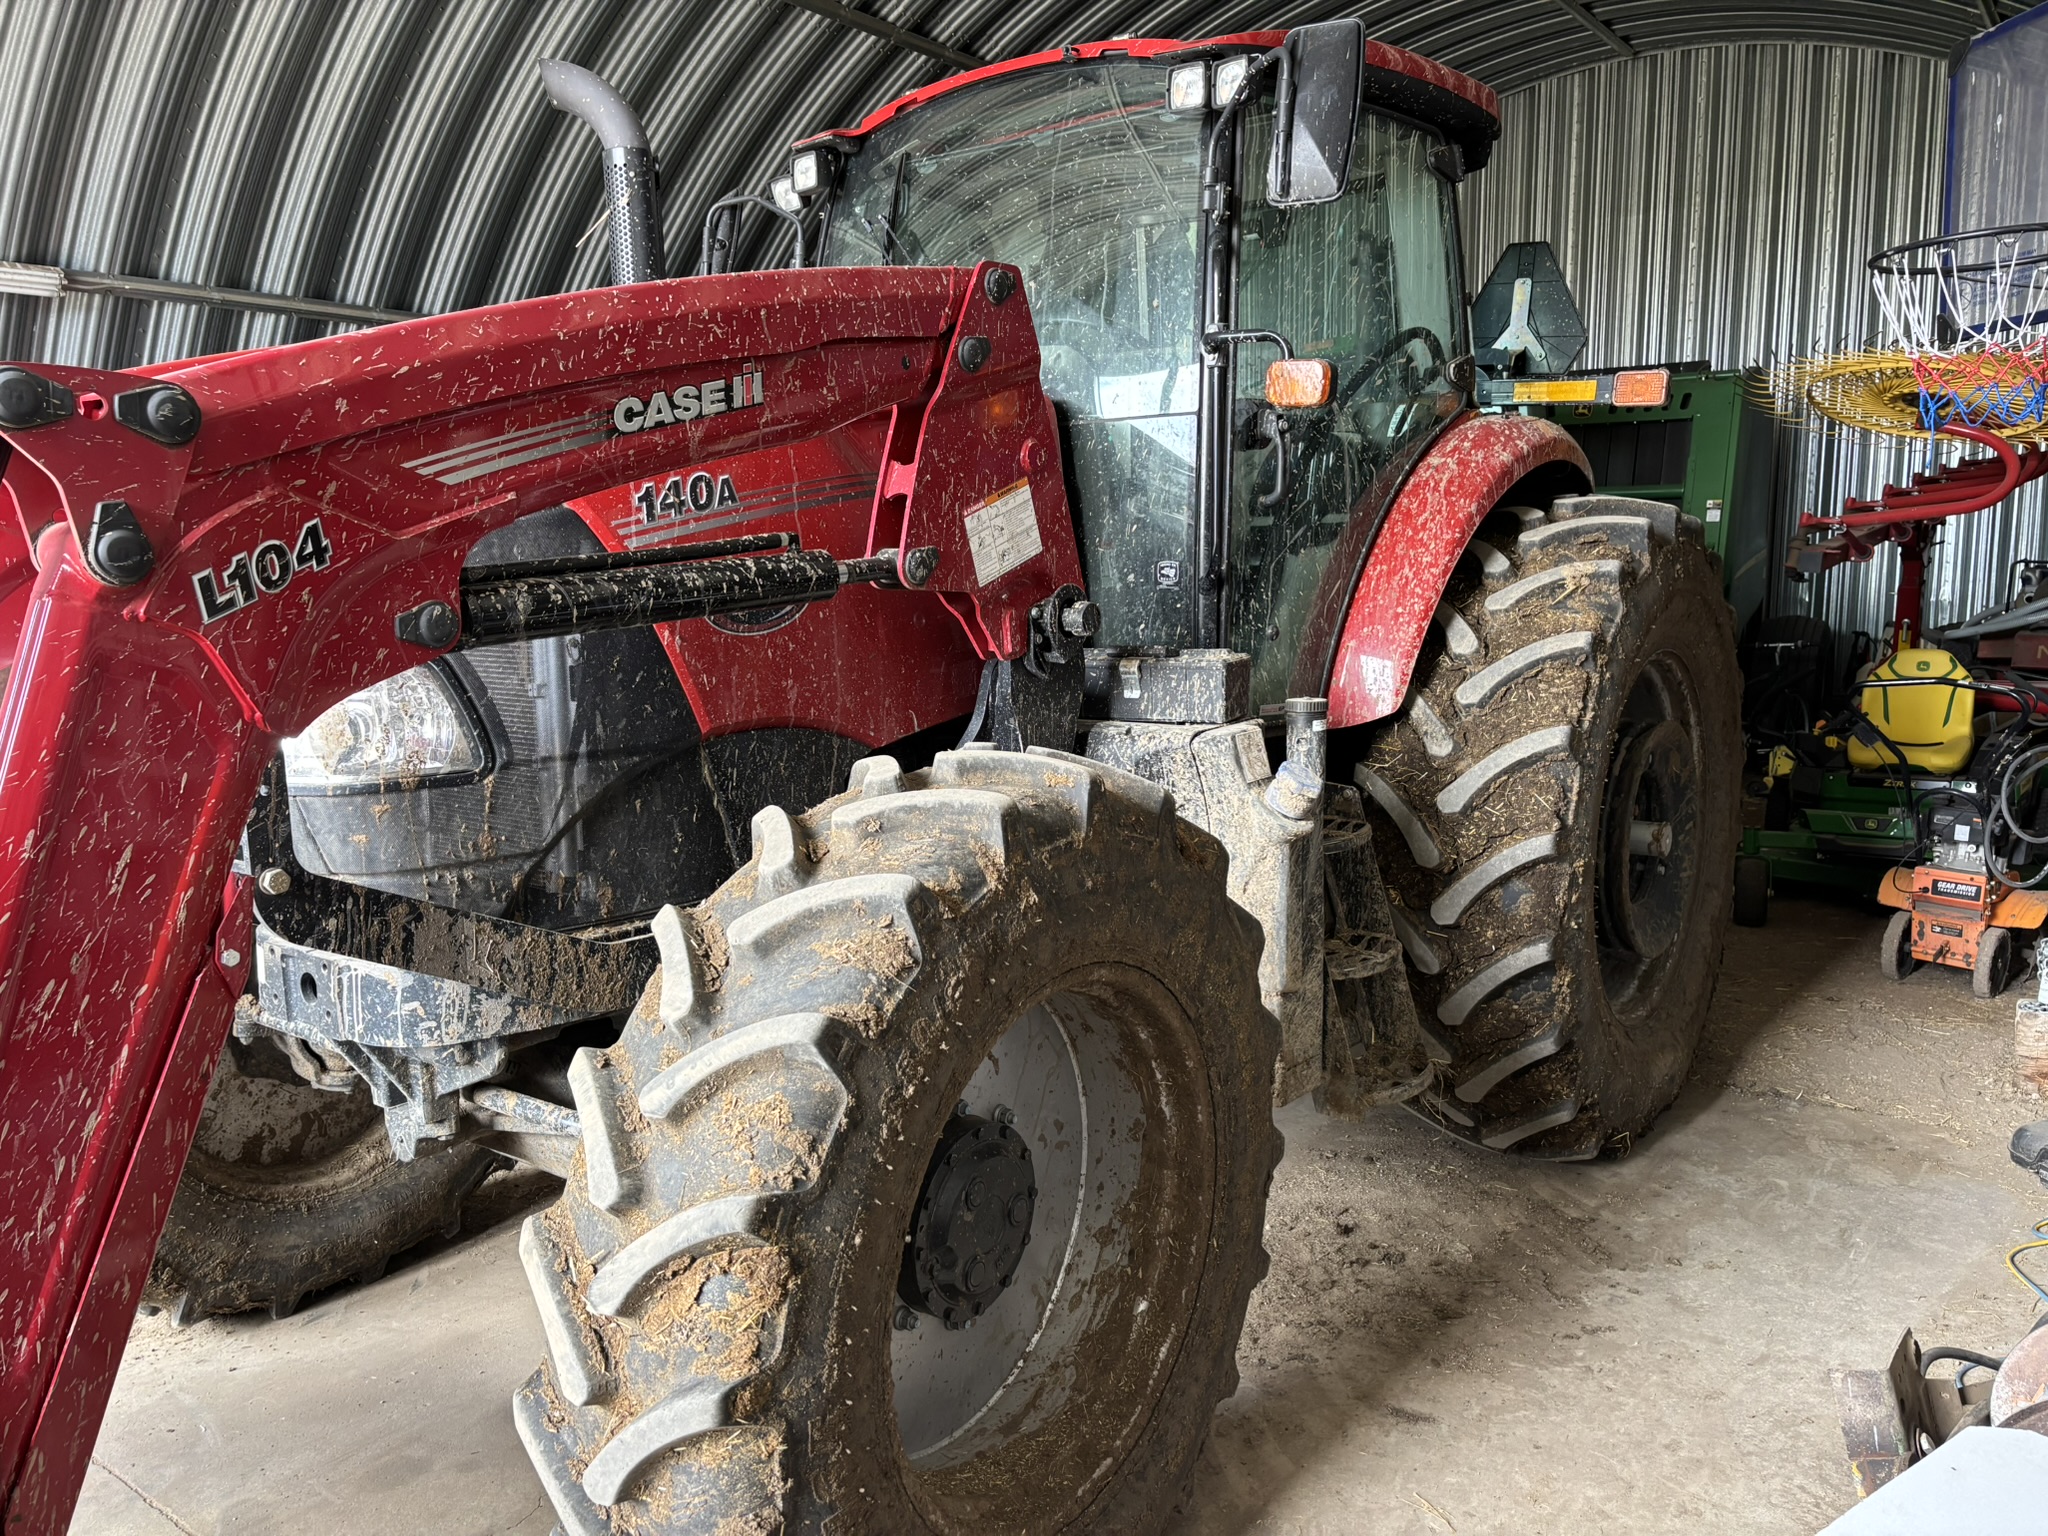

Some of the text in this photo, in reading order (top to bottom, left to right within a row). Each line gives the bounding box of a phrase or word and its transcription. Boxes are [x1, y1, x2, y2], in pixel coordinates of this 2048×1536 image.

[613, 378, 728, 433] CASE
[634, 471, 740, 526] 140A
[191, 516, 334, 626] L104
[1882, 778, 1917, 788] ZTRK
[1937, 881, 1978, 893] GEAR DRIVE
